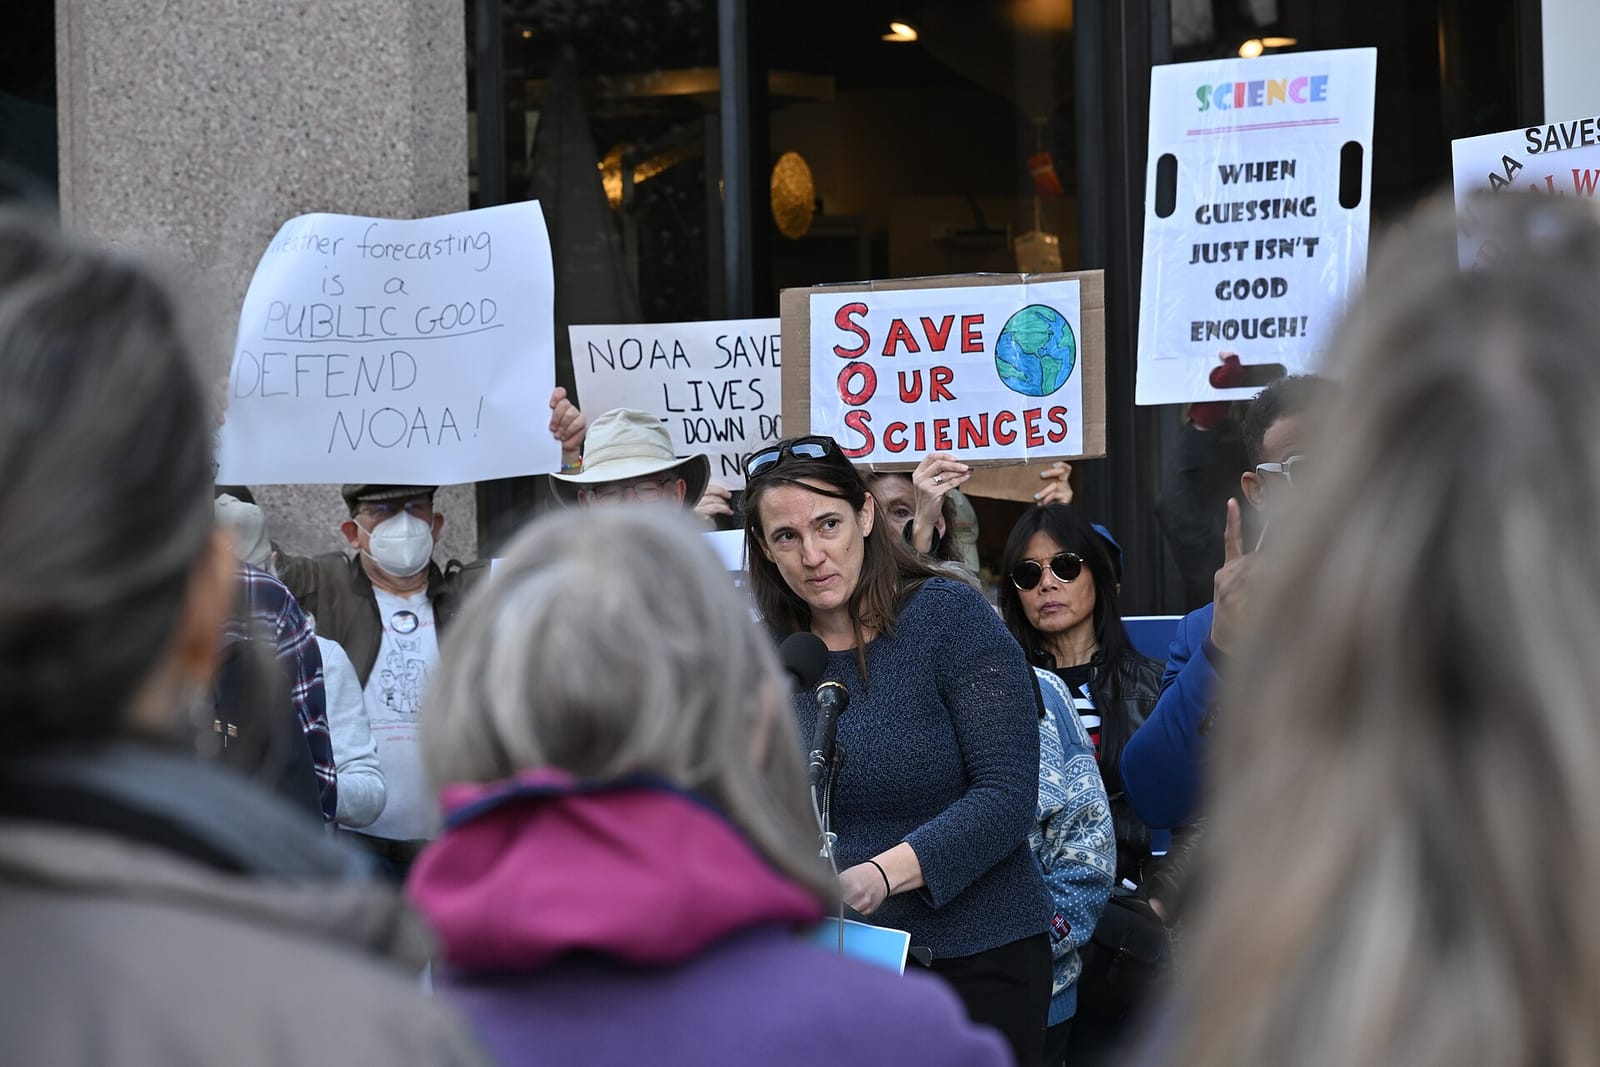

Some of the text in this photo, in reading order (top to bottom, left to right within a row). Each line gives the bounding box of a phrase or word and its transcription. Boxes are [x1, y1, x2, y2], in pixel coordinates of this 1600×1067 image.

[1195, 75, 1329, 112] SCIENCE
[1525, 117, 1600, 154] SAVE
[1218, 159, 1298, 185] WHEN
[1195, 196, 1317, 225] GUESSING
[356, 223, 492, 272] forecasting
[1189, 237, 1319, 265] JUST ISN'T
[322, 265, 408, 296] is a
[1215, 277, 1288, 301] GOOD
[264, 298, 497, 338] PUBLIC GOOD
[833, 302, 985, 359] SAVE
[1190, 316, 1308, 342] ENOUGH!
[588, 338, 691, 373] NOAA
[235, 351, 416, 399] DEFEND
[837, 361, 957, 406] OUR
[663, 379, 764, 412] LIVES
[329, 397, 484, 454] NOAA!
[683, 416, 746, 445] DOWN
[838, 406, 1068, 458] SCIENCES
